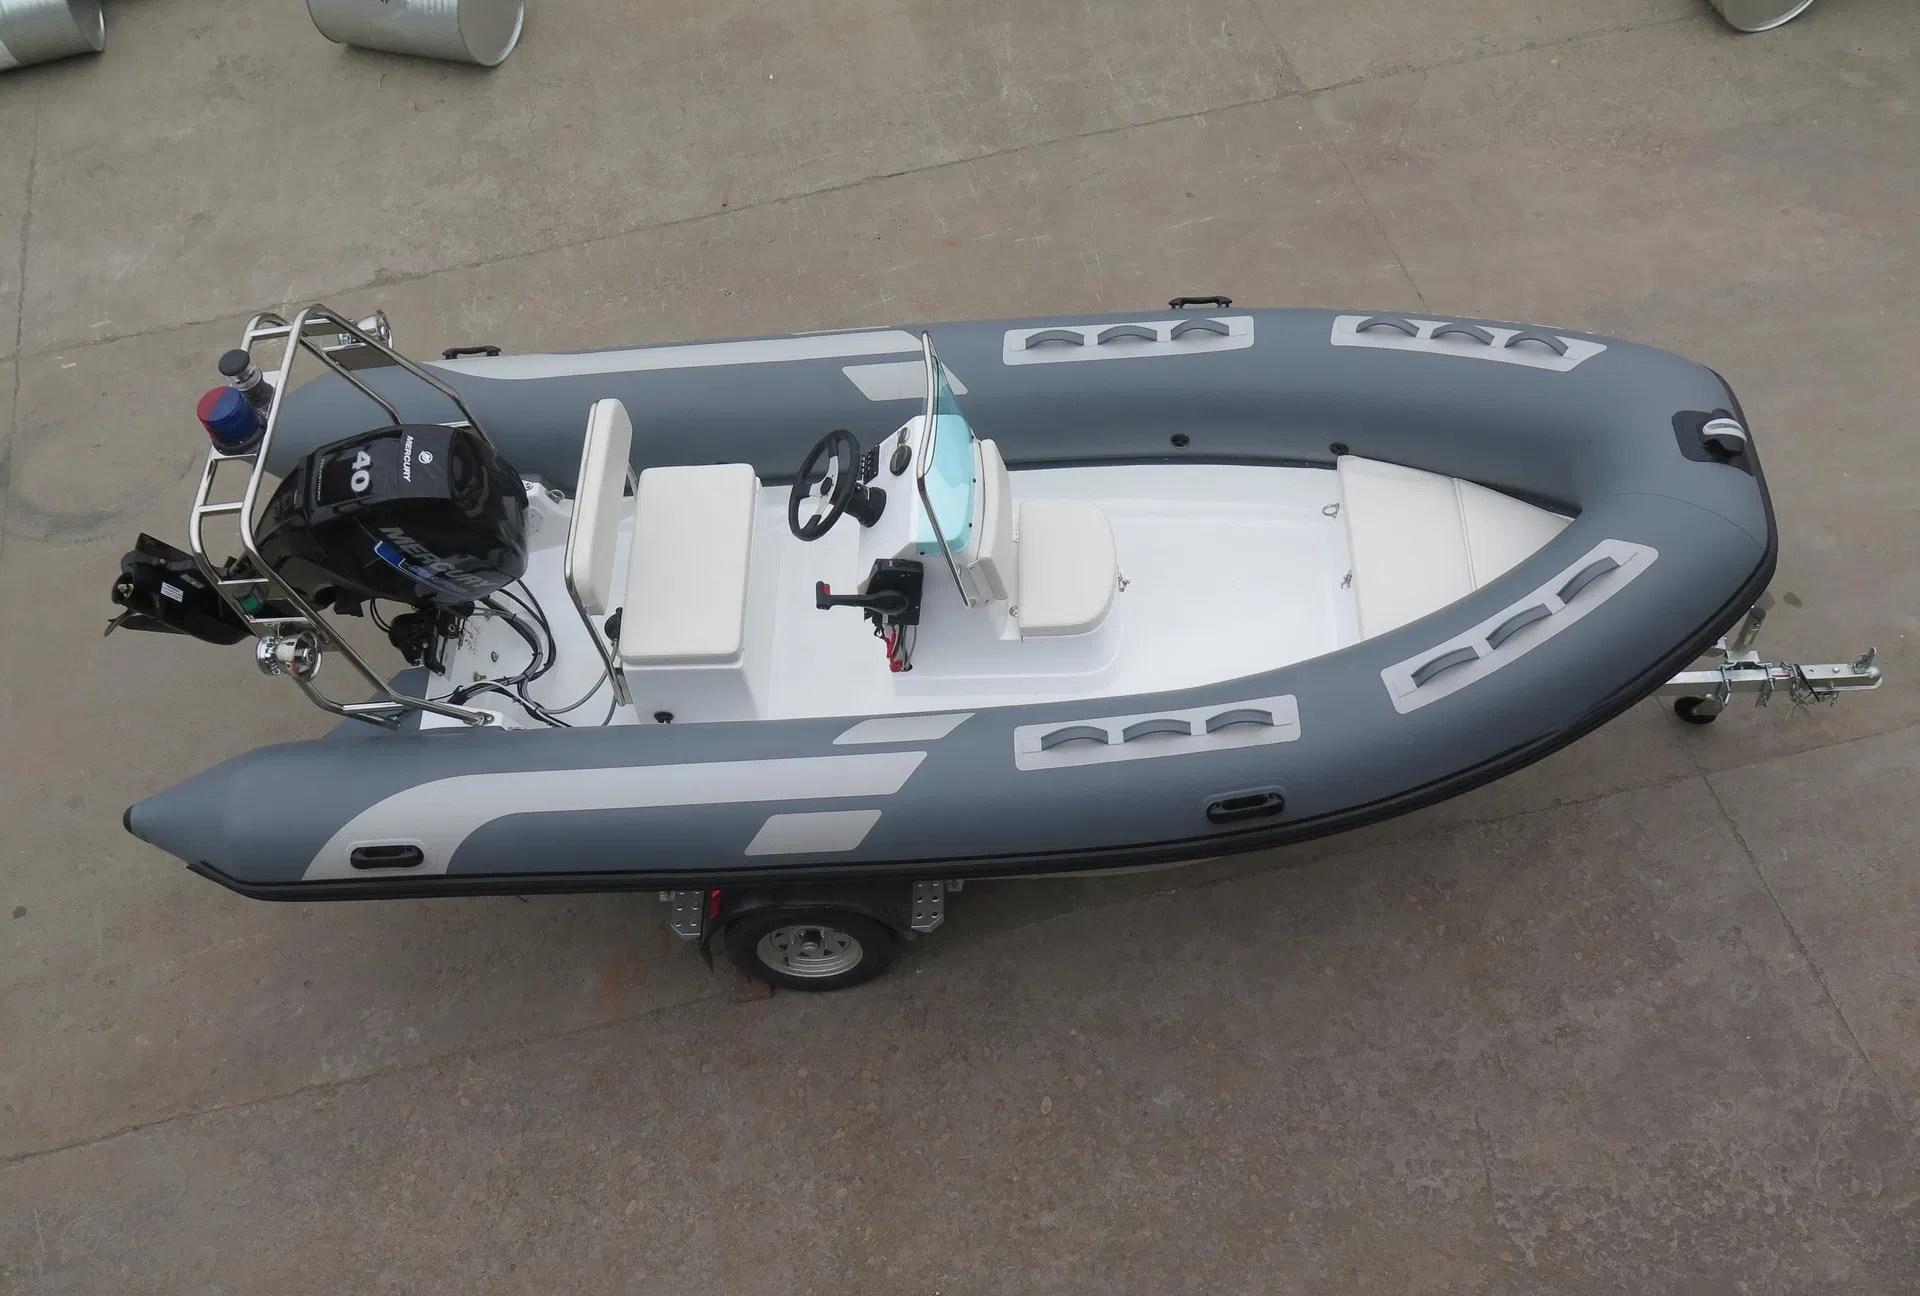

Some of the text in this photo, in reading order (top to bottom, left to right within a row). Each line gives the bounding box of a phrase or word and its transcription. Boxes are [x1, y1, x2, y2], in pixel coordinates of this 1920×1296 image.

[351, 451, 371, 492] 40
[403, 435, 414, 482] MERCURY
[379, 526, 498, 588] MERCURY
